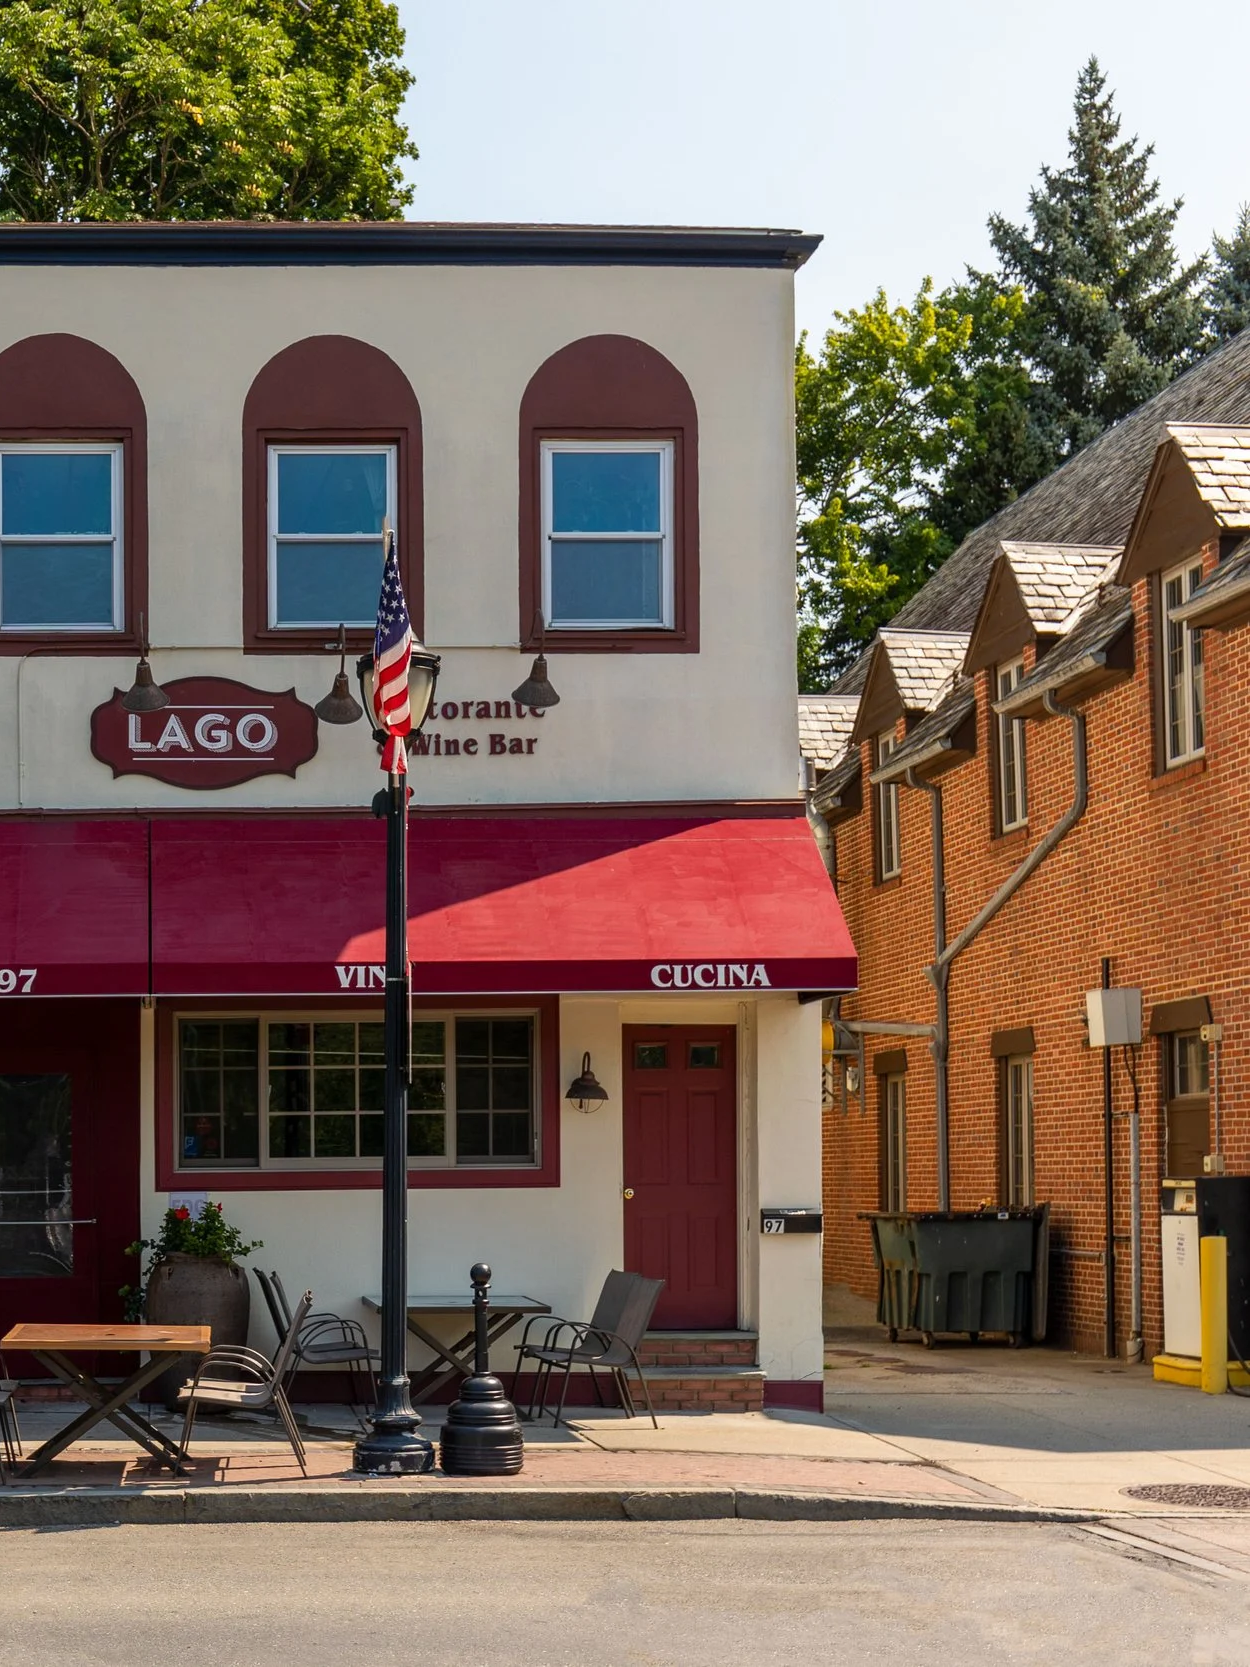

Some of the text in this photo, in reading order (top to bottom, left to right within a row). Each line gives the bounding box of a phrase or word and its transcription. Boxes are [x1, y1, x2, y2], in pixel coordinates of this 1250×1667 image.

[428, 700, 546, 720] torante
[128, 713, 278, 752] LAGO
[489, 733, 538, 755] Bar
[334, 965, 386, 988] VIN
[650, 964, 772, 988] CUCINA
[765, 1220, 783, 1232] 97
